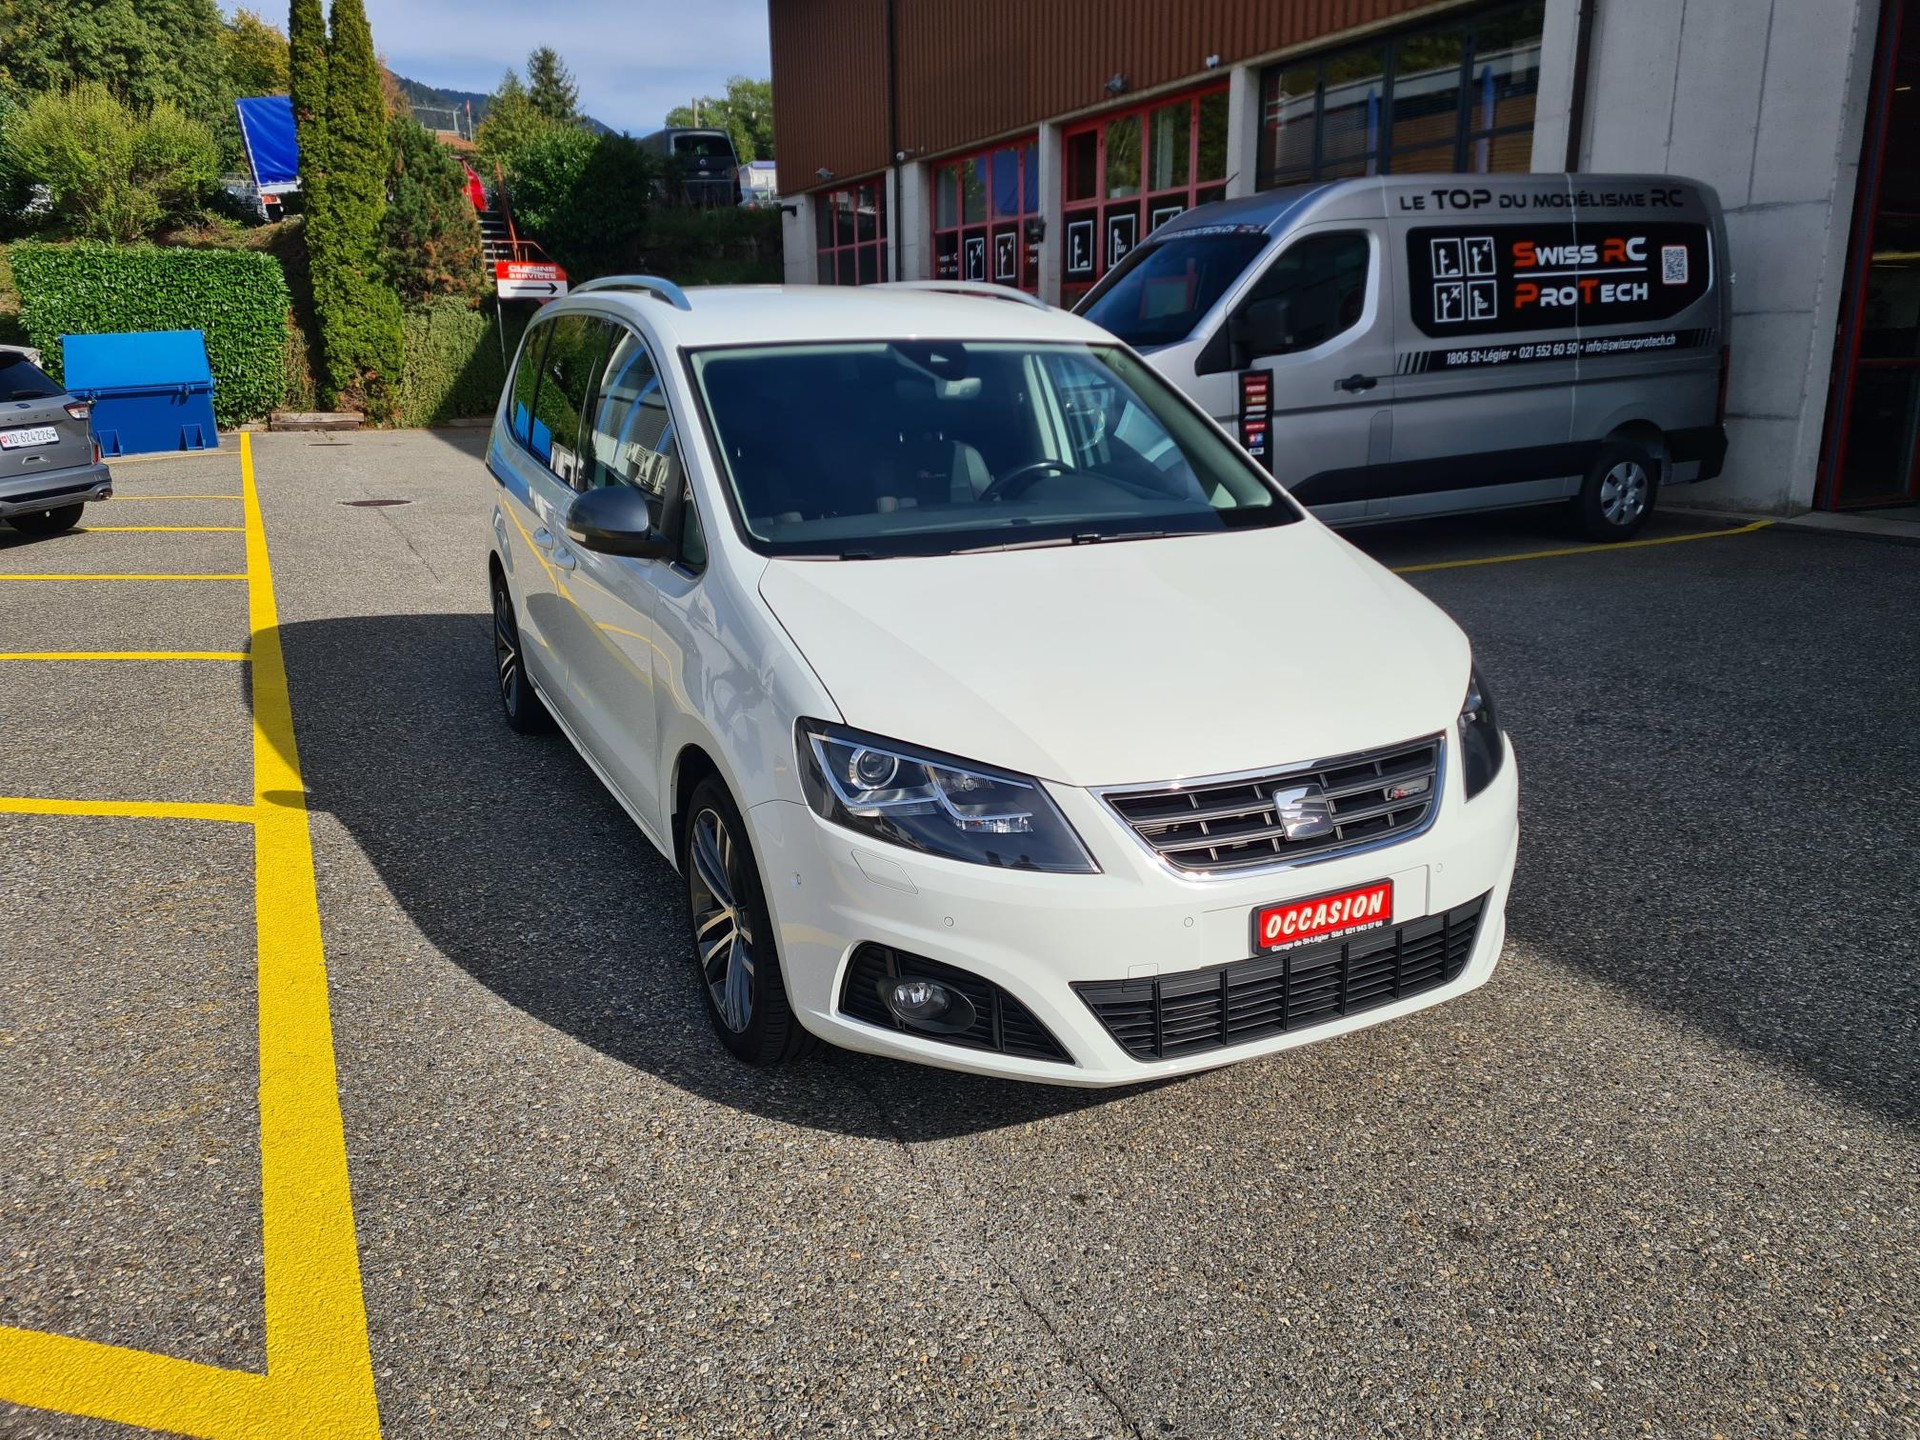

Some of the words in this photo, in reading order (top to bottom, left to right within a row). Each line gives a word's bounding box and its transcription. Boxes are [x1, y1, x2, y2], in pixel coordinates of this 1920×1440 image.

[1398, 195, 1426, 211] LE
[1430, 188, 1493, 210] TOP
[1499, 193, 1527, 209] DU
[1532, 190, 1647, 209] MODÉLISME
[1650, 188, 1685, 208] RC
[1512, 241, 1598, 267] SWISS
[1602, 236, 1648, 263] RC
[1514, 279, 1649, 309] PROTECH
[1446, 351, 1469, 365] 1806
[1470, 347, 1512, 364] St-Légier
[1518, 345, 1535, 359] 021
[1535, 344, 1552, 357] 552
[1552, 342, 1565, 356] 60
[1566, 342, 1578, 355] 50
[1265, 890, 1385, 939] OCCASION
